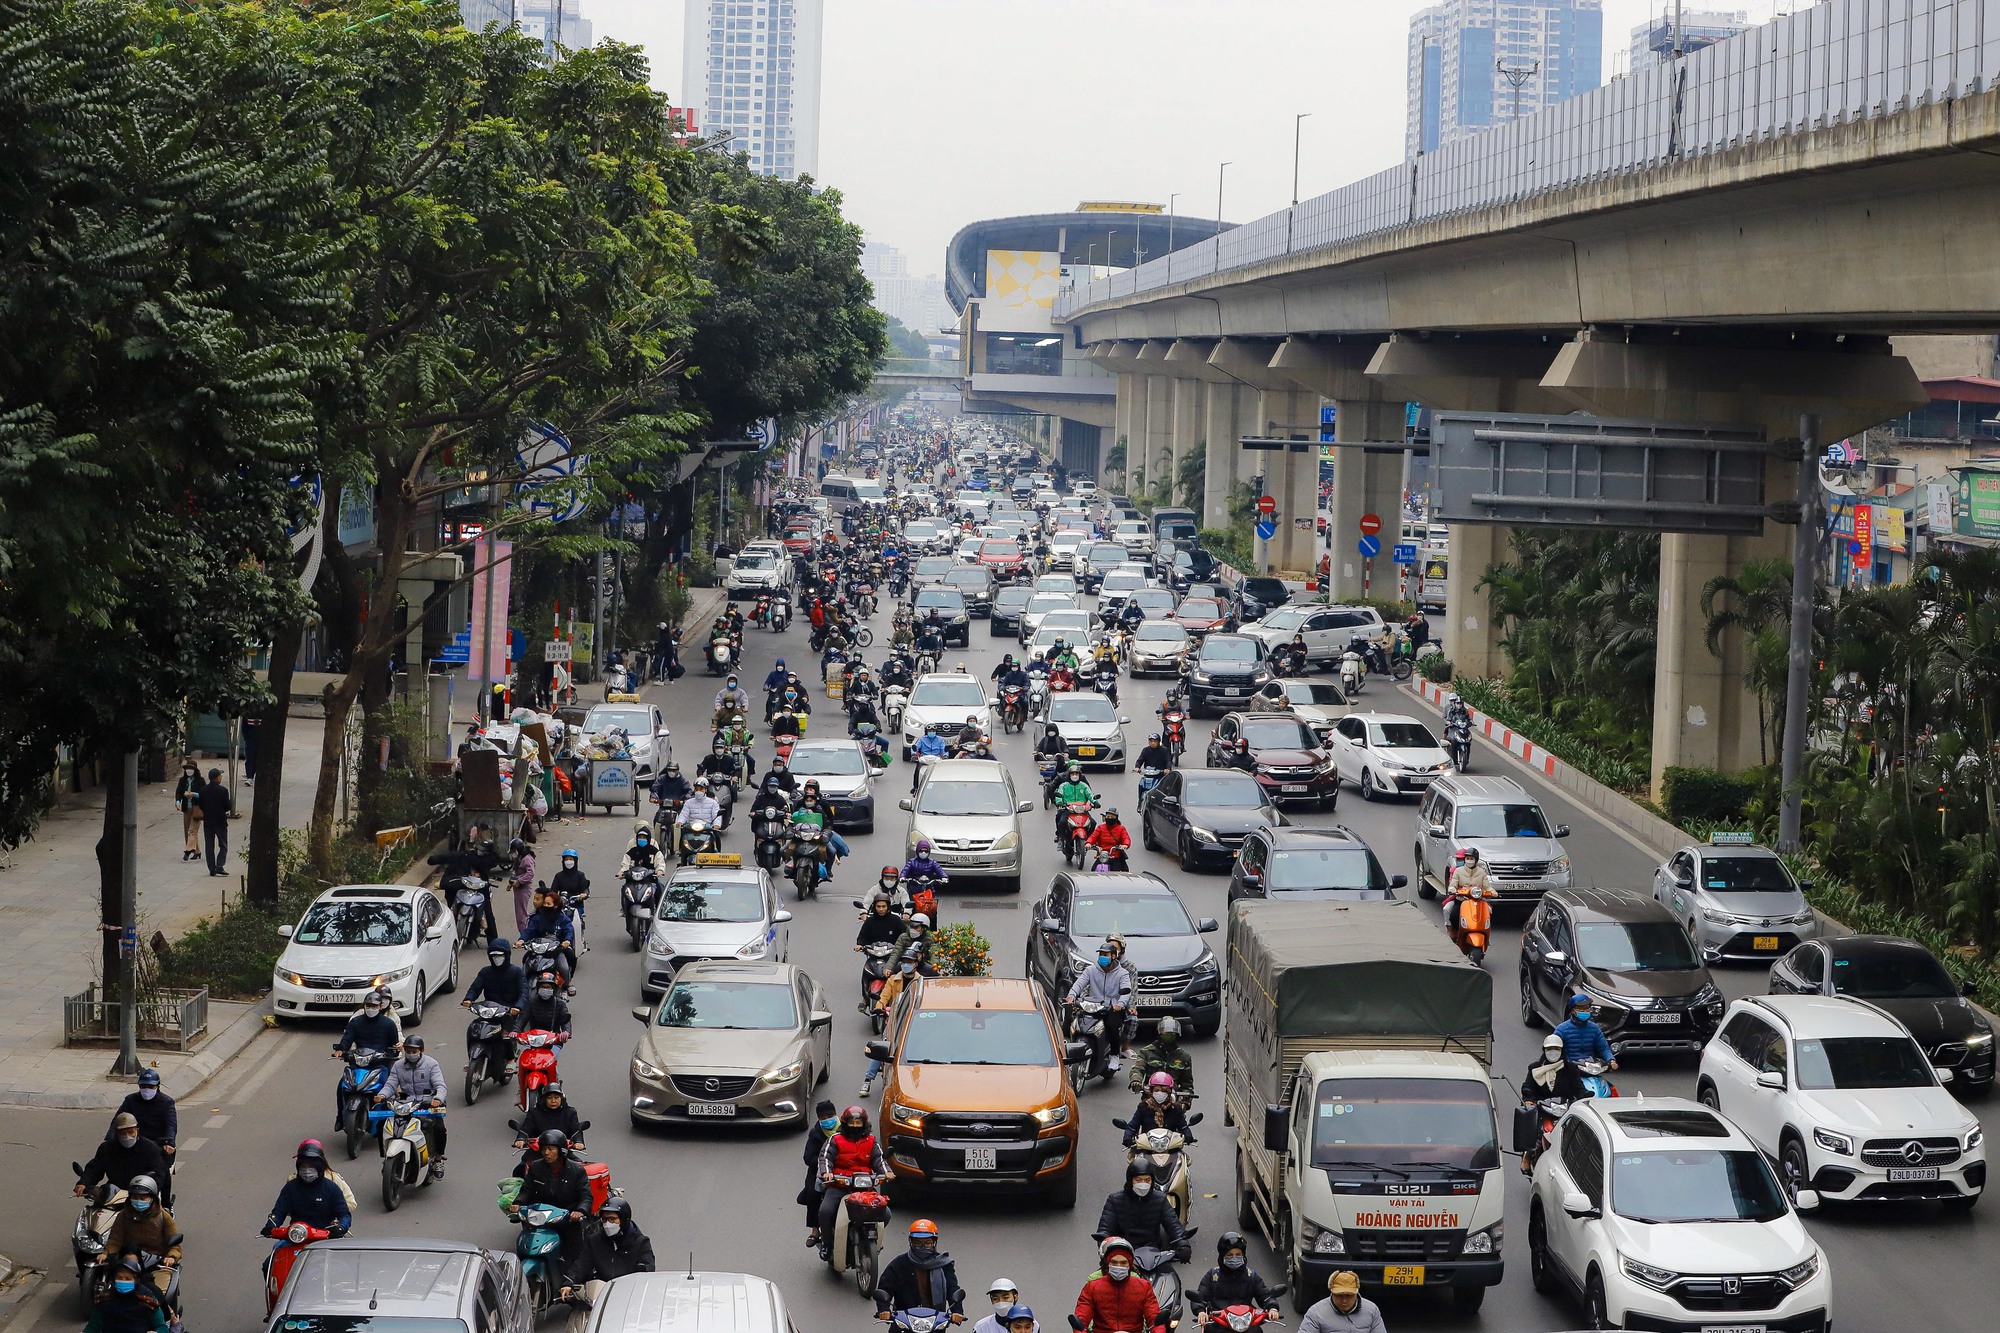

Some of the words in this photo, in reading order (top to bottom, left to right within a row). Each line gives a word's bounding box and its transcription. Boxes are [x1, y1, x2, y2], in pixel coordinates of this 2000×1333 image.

[972, 1149, 988, 1158] 51C
[966, 1159, 995, 1169] 710.34
[1384, 1185, 1430, 1194] ISUZU
[1389, 1199, 1409, 1208] VẬN
[1411, 1198, 1425, 1207] TẢI
[1355, 1210, 1402, 1228] HOÀNG
[1405, 1209, 1459, 1228] NGUYỄN
[1396, 1267, 1413, 1275] 29H
[1388, 1276, 1419, 1284] 760.71
